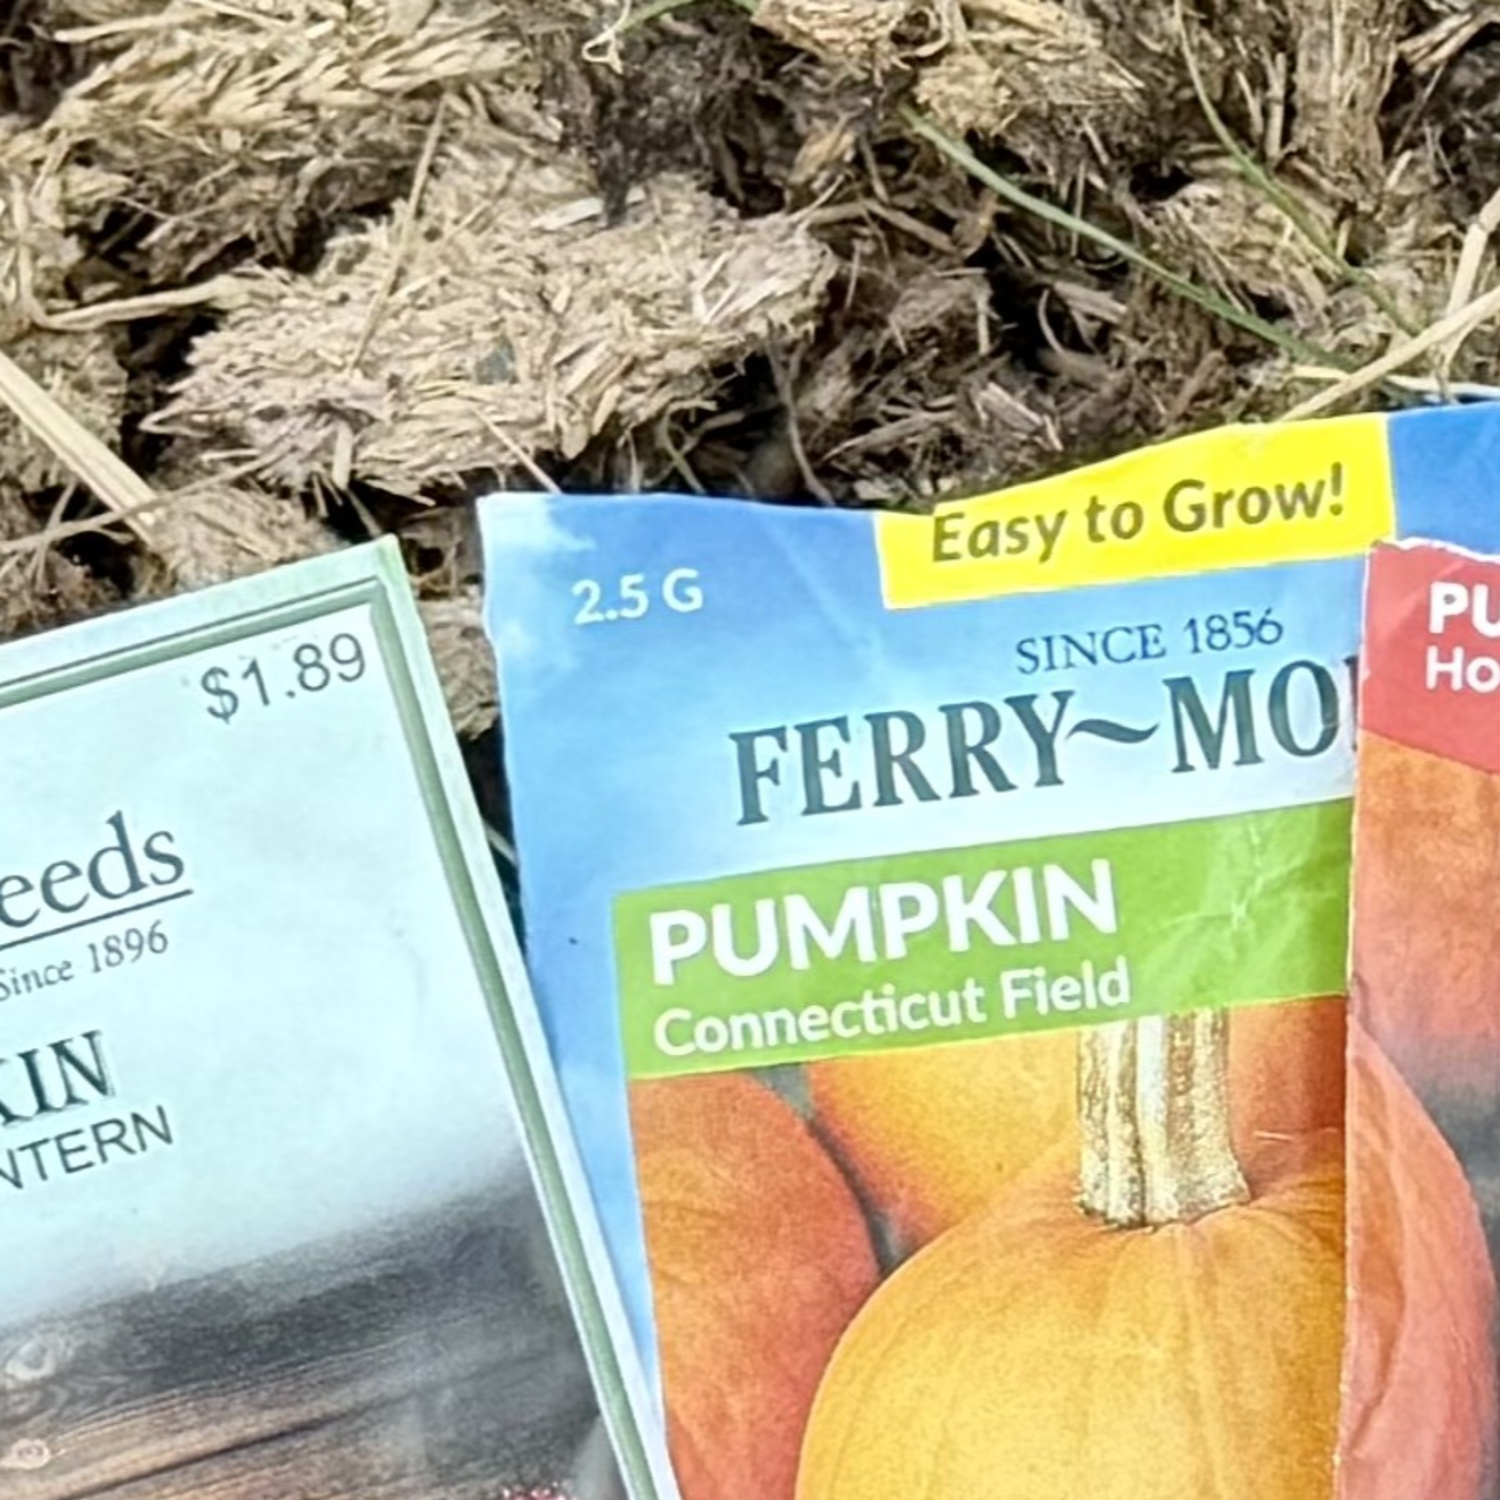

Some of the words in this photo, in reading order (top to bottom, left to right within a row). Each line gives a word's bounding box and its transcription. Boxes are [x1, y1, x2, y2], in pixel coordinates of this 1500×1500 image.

[930, 510, 1067, 565] Easy
[1084, 493, 1144, 544] to
[1162, 462, 1346, 534] Grow!
[571, 572, 649, 626] 2.5
[663, 567, 705, 615] G
[1014, 622, 1168, 676] SINCE
[1183, 607, 1284, 655] 1856
[200, 633, 366, 723] $1.89
[86, 918, 169, 974] 1896
[649, 857, 1120, 987] PUMPKIN
[654, 978, 986, 1058] Connecticut
[1002, 956, 1133, 1020] Field
